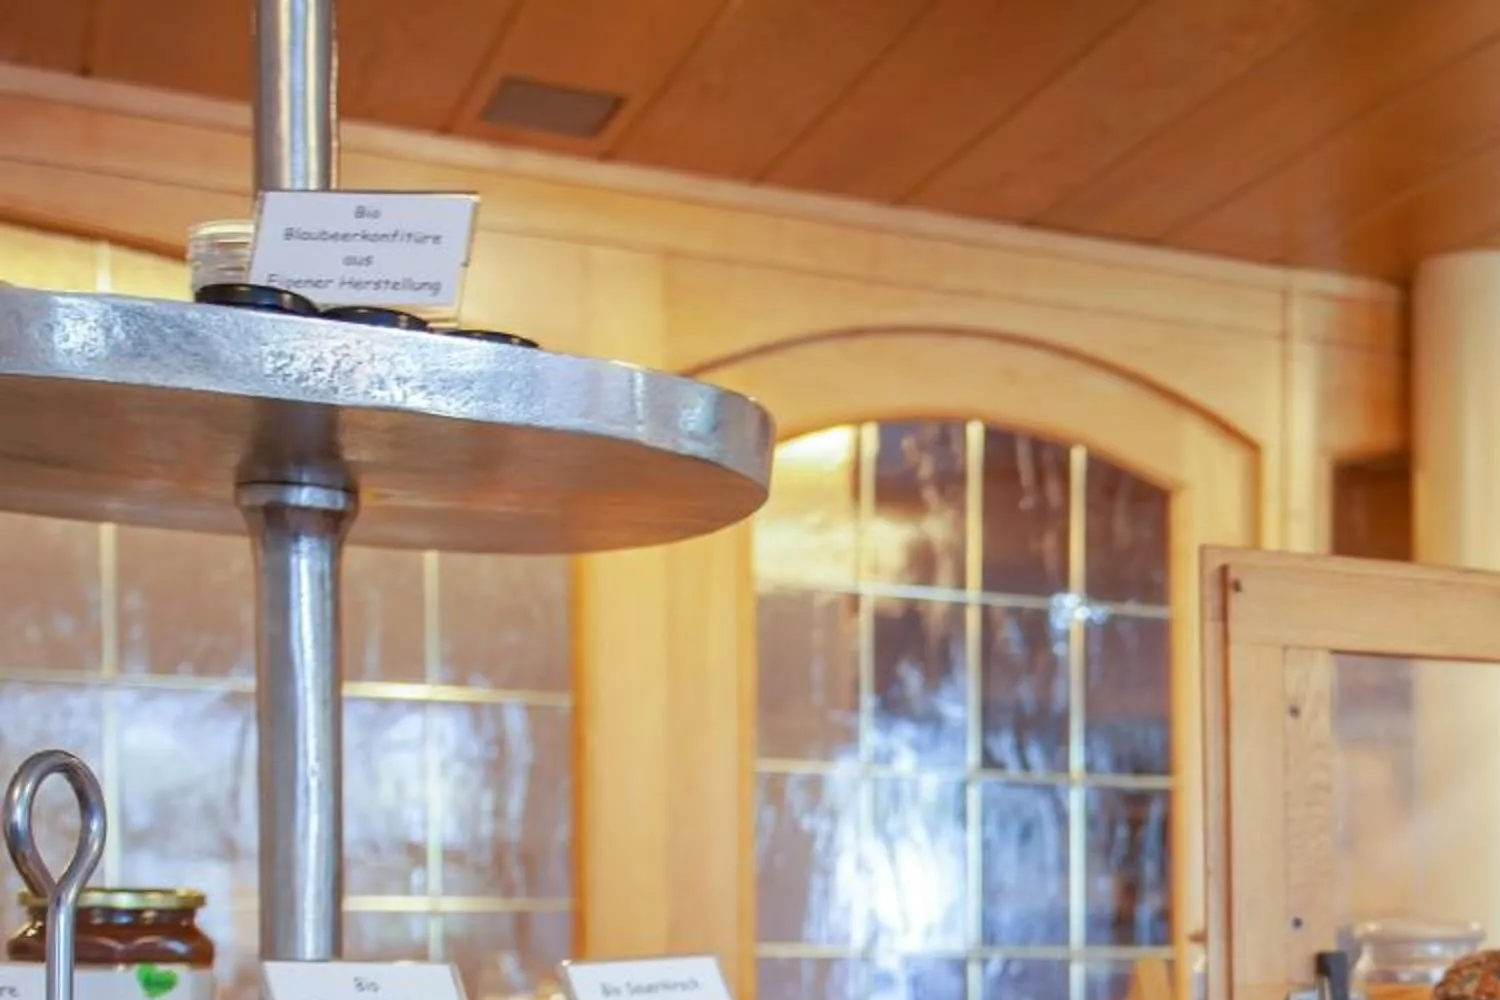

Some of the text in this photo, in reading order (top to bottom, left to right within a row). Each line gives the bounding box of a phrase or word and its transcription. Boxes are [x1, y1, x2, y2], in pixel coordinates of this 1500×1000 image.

[353, 205, 382, 219] Bio
[283, 227, 443, 245] Blaubeerkonfitüre
[342, 255, 374, 267] aus
[338, 276, 443, 296] Herstellung
[354, 976, 381, 992] Bio
